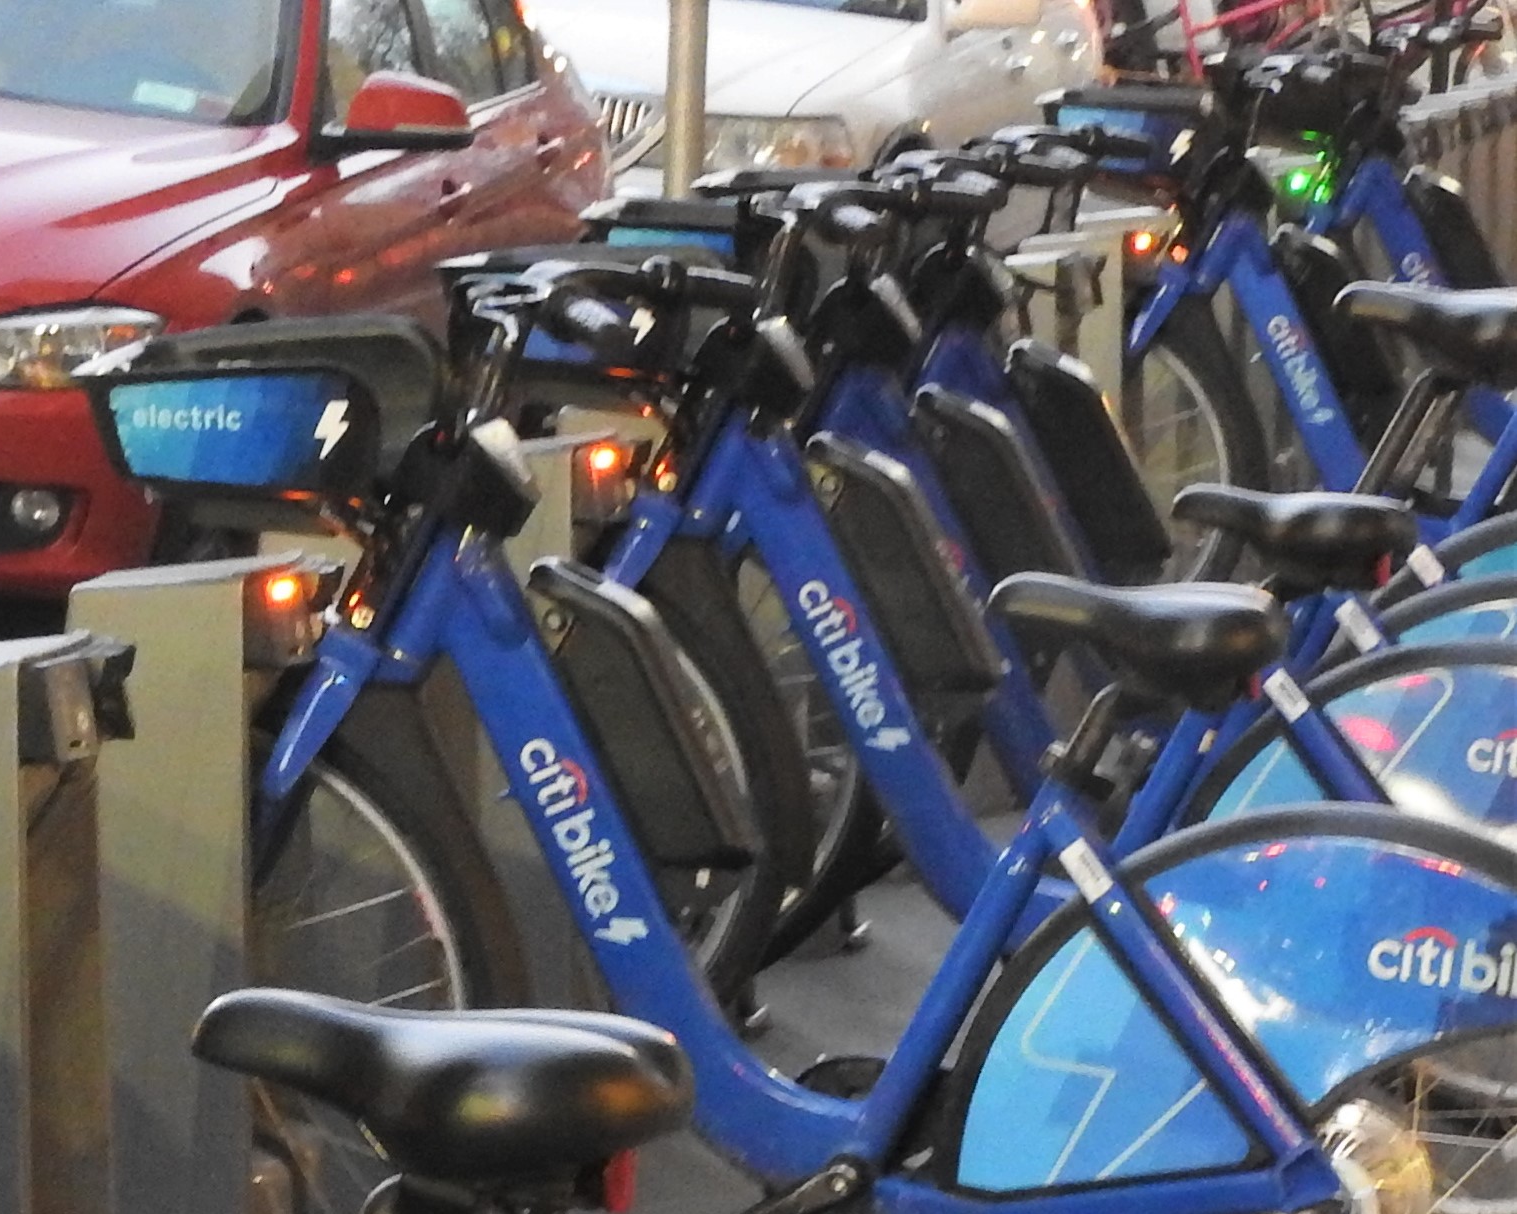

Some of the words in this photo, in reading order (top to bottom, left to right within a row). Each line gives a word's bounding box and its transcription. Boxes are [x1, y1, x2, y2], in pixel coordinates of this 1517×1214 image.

[133, 404, 242, 431] electric
[798, 579, 856, 648] citi
[827, 637, 886, 730] bike
[520, 737, 588, 818] citi
[551, 806, 620, 919] bike
[1367, 926, 1458, 988] citi
[1459, 938, 1517, 999] bi
